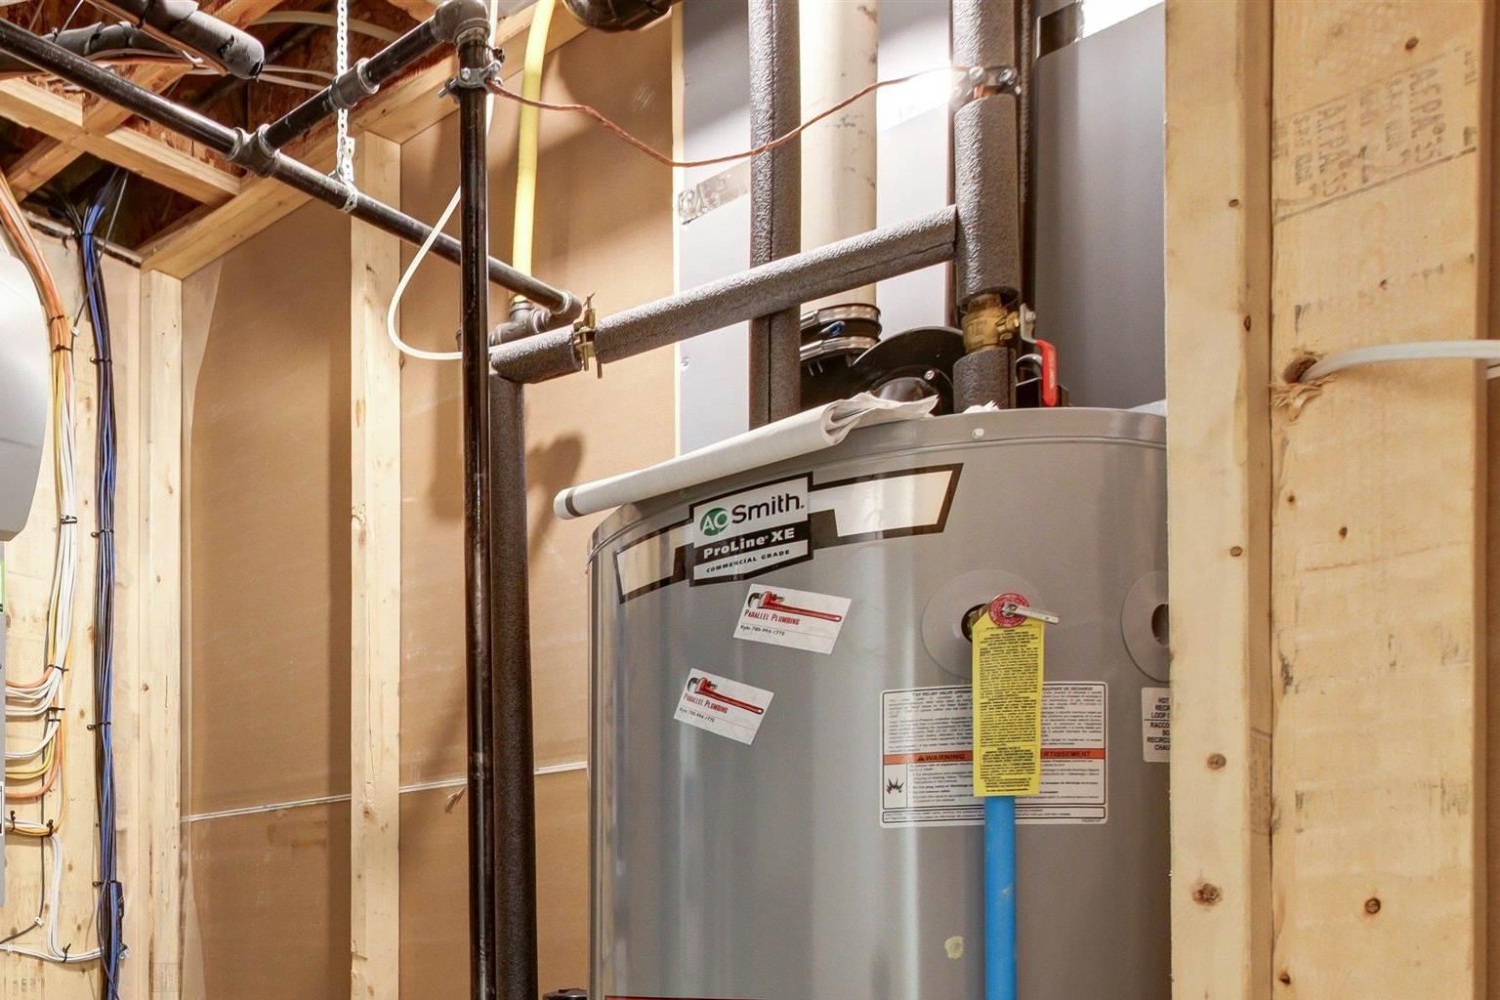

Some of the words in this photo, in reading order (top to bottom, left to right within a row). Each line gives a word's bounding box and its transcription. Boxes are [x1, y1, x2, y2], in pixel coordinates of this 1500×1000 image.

[771, 528, 794, 542] XE
[707, 557, 756, 572] COMMERCIAL
[761, 550, 790, 559] GRADE
[744, 609, 768, 620] PARALLEL
[771, 614, 800, 625] PLUMBING
[684, 693, 702, 705] PARALLEL
[705, 699, 728, 713] PLUMBING
